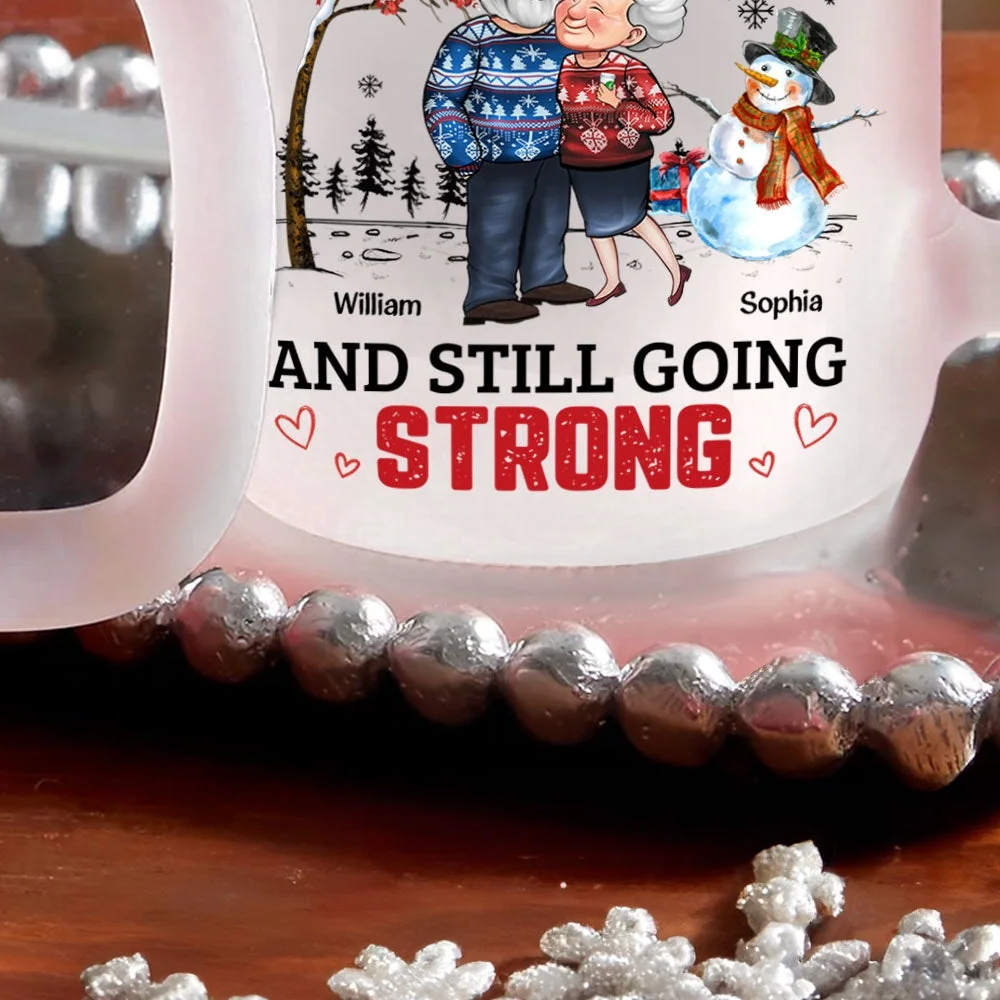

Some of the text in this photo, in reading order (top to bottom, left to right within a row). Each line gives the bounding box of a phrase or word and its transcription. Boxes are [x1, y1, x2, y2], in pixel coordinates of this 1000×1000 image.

[333, 291, 422, 317] William
[740, 289, 823, 321] Sophia
[268, 336, 847, 394] AND STILL GOING
[376, 403, 732, 492] STRONG
